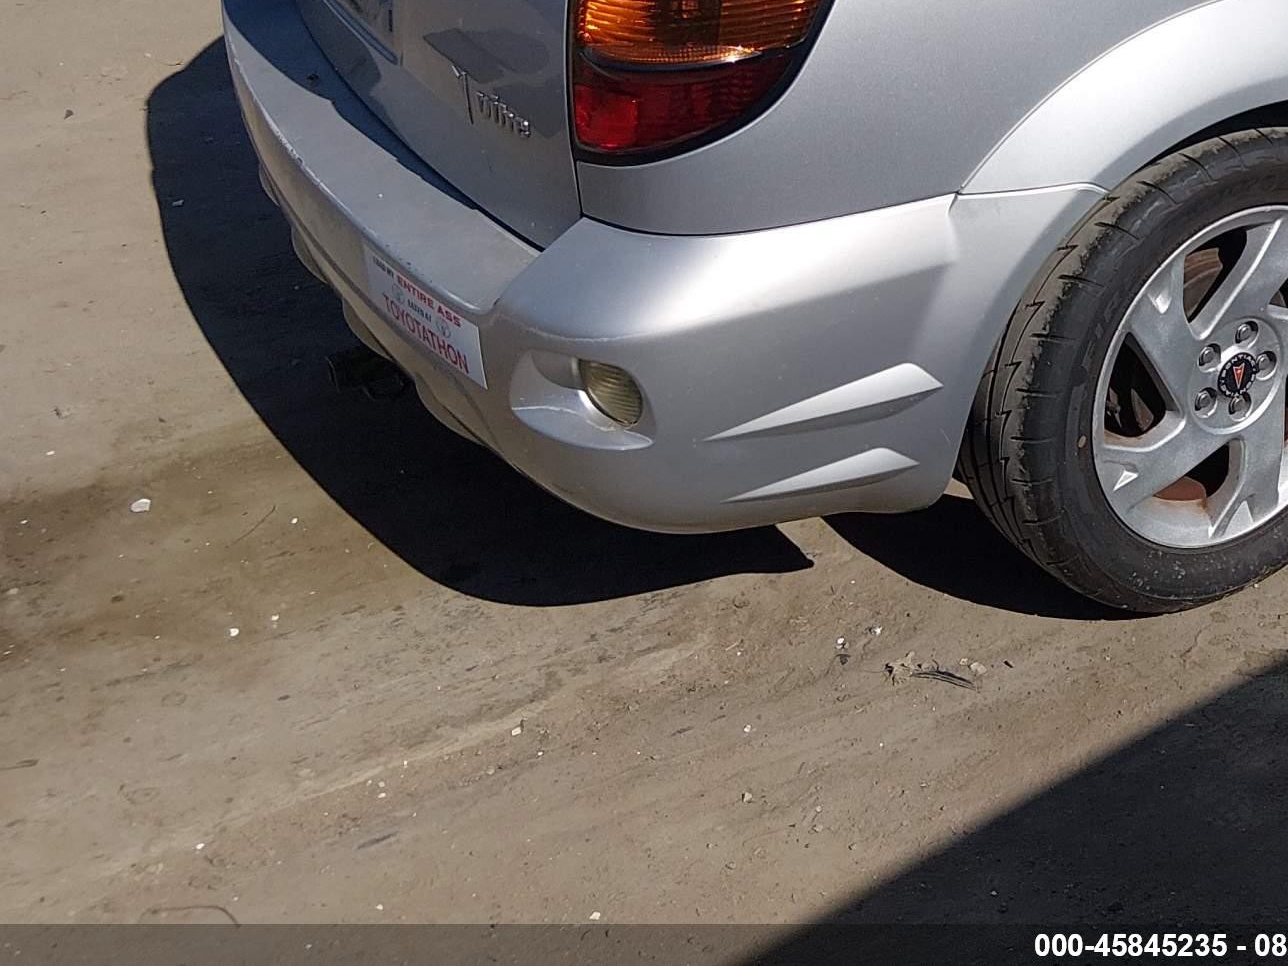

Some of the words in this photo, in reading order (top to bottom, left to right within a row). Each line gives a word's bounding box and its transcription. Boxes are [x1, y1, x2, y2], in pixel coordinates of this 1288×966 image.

[382, 291, 470, 374] TOYOTATHON
[397, 274, 434, 310] ENTIRE
[436, 305, 462, 328] ASS
